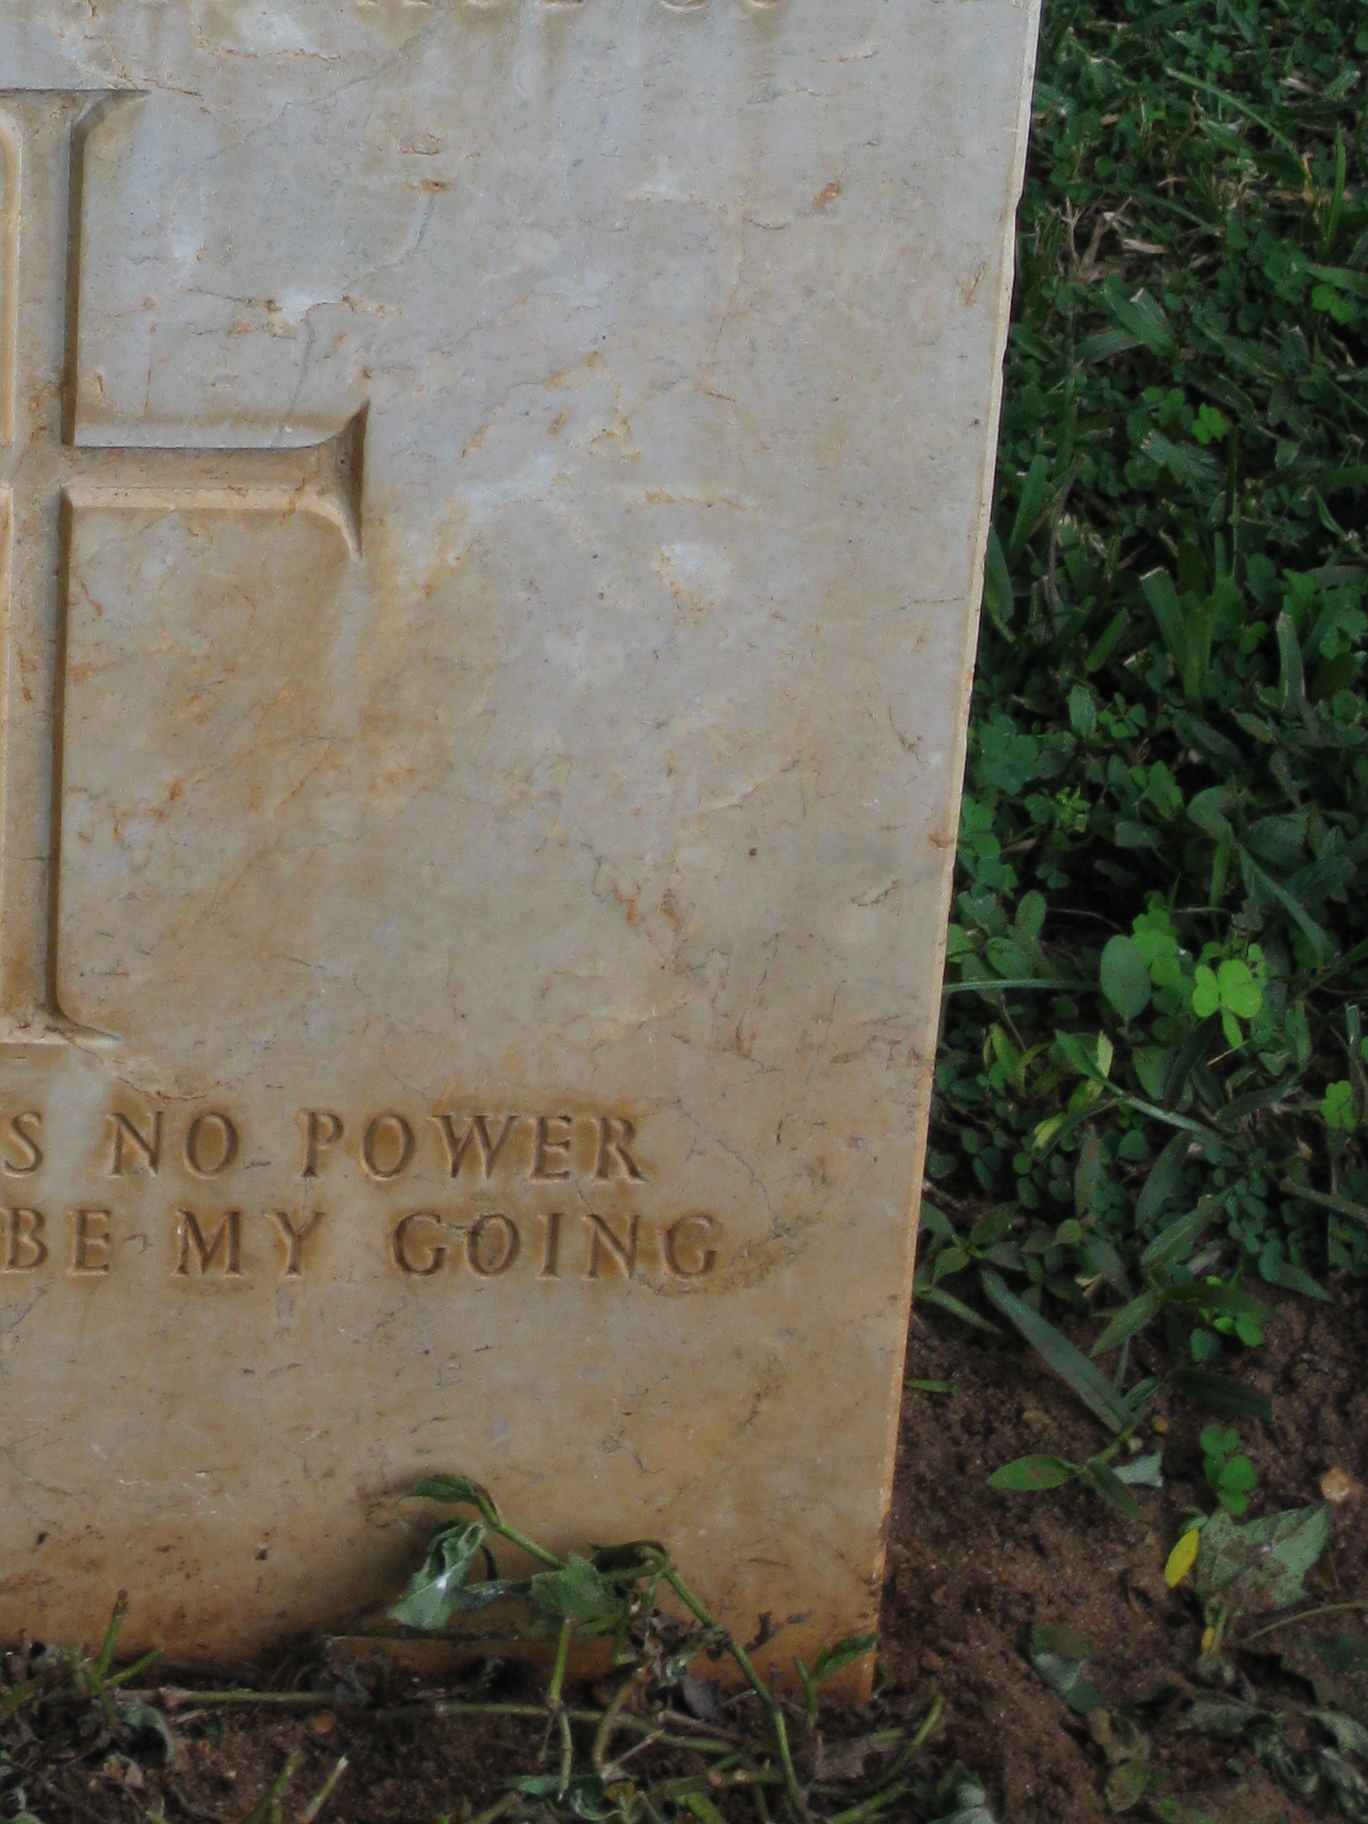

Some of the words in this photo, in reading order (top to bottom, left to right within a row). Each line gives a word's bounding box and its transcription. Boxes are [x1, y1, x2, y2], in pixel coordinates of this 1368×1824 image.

[106, 1111, 240, 1178] NO
[296, 1110, 649, 1182] POWER
[0, 1207, 111, 1275] BE
[174, 1210, 325, 1277] MY
[389, 1212, 718, 1280] GOING
